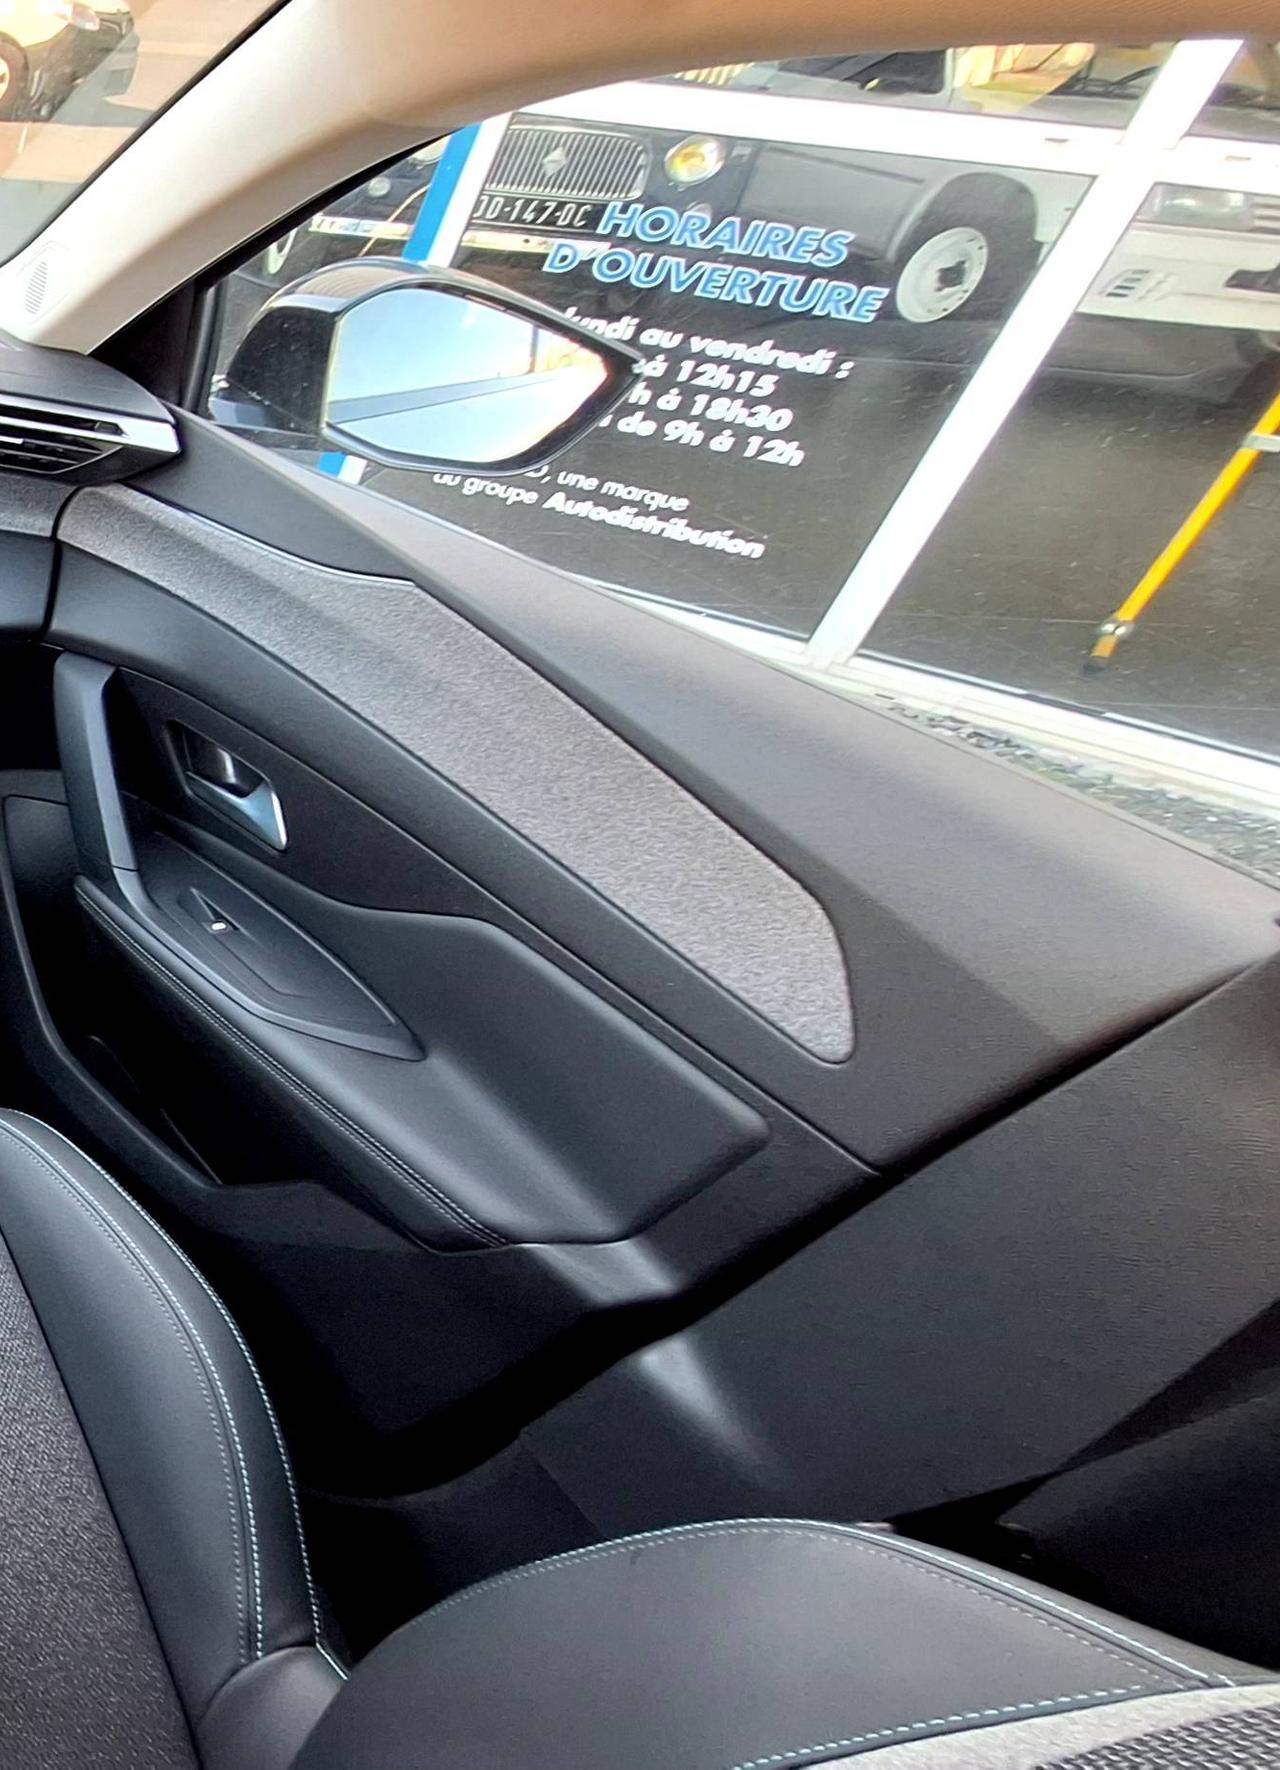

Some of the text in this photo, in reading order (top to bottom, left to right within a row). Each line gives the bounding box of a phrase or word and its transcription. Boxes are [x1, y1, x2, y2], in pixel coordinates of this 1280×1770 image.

[596, 200, 857, 268] HORAIRES
[542, 240, 891, 324] D'OUVERTURE
[639, 328, 684, 349] au
[689, 336, 838, 375] vendredi
[675, 359, 781, 398] 12h15
[689, 393, 794, 432] 18h30
[616, 411, 658, 437] de
[663, 419, 705, 446] 9h
[742, 435, 806, 467] 12h
[557, 470, 604, 492] une
[600, 481, 691, 512] marque
[462, 477, 540, 506] groupe
[542, 491, 767, 559] Autodistribution
